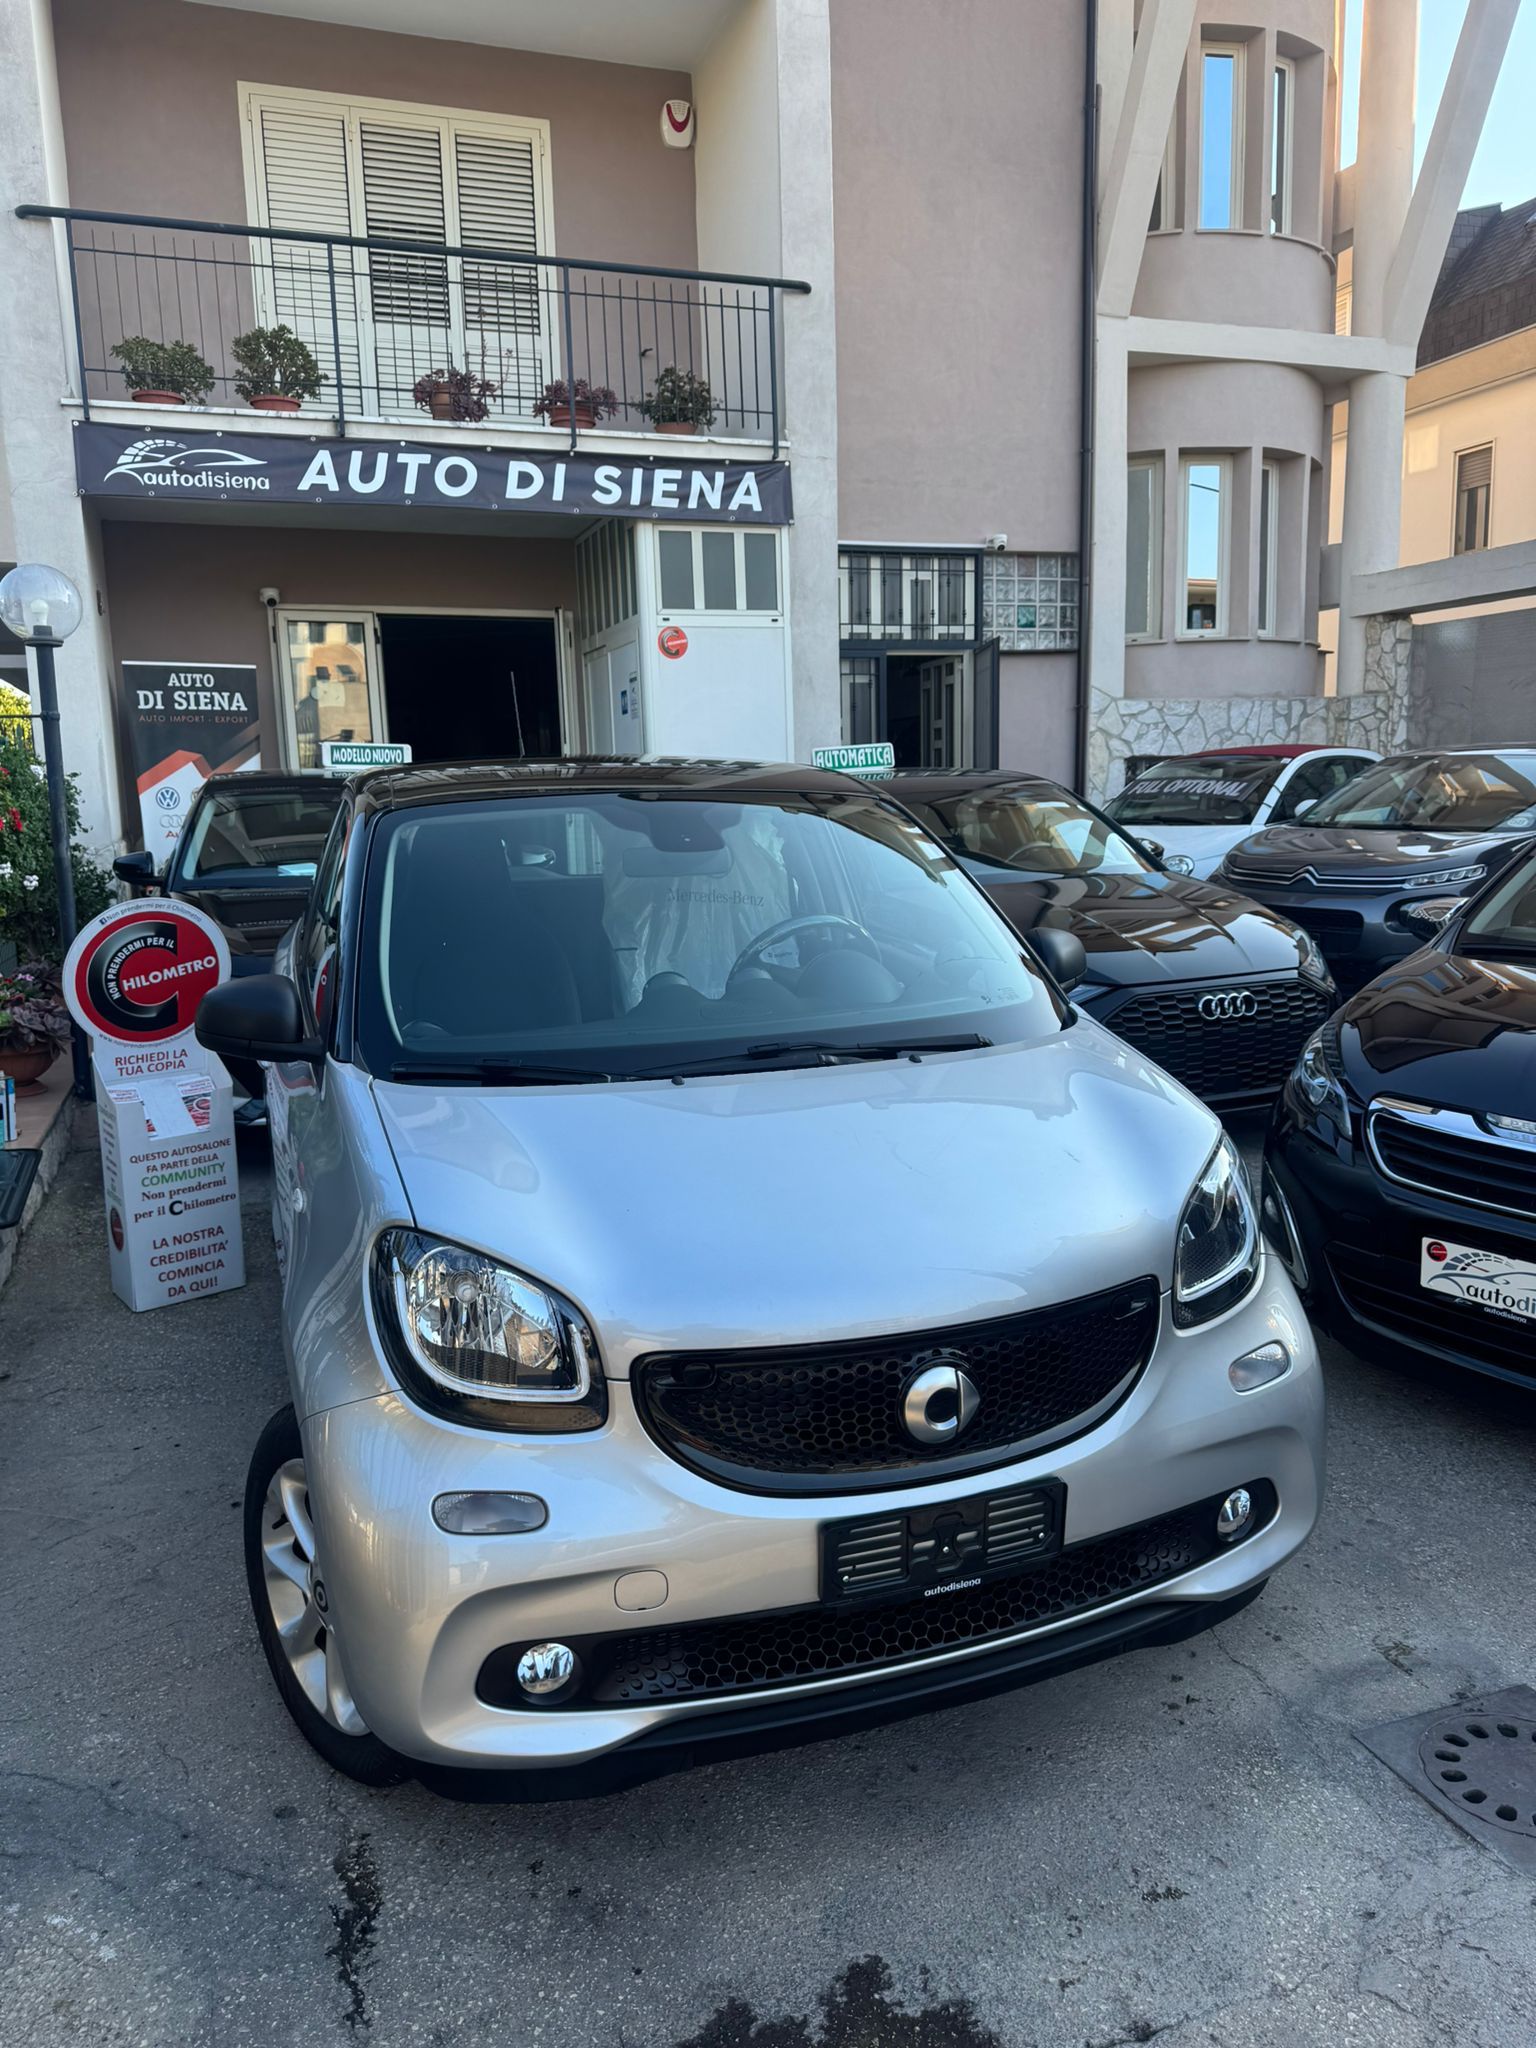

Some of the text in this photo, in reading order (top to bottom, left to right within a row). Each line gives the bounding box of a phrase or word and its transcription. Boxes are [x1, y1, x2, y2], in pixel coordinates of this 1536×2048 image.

[143, 470, 270, 491] autodisiena
[297, 449, 763, 512] AUTO DI SIENA
[167, 673, 215, 687] AUTO
[136, 690, 248, 711] DI SIENA
[138, 714, 166, 723] AUTO
[170, 715, 205, 723] IMPORT
[215, 716, 249, 724] EXPORT
[332, 748, 403, 763] MODELLO NUOVO
[816, 747, 892, 768] AUTOMATICA
[1129, 779, 1247, 796] FULL OPTIONAL
[665, 888, 765, 907] Mercedes-Benz
[147, 936, 165, 947] PER
[166, 938, 175, 949] IL
[107, 940, 145, 980] PRENDERMI
[107, 981, 121, 1000] NON
[114, 1048, 189, 1067] RICHIEDI LA
[117, 1059, 186, 1077] TUA COPIA
[129, 1137, 232, 1165] QUESTO AUTOSALONE
[146, 1153, 219, 1174] FA PARTE DELLA
[141, 1162, 226, 1188] COMMUNITY
[142, 1176, 227, 1202] Non prendermi
[134, 1190, 237, 1223] per il Chilometro
[152, 1224, 225, 1250] LA NOSTRA
[158, 1258, 225, 1283] COMINCIA
[168, 1276, 218, 1298] DA QUI!
[924, 1578, 981, 1597] autodisiena
